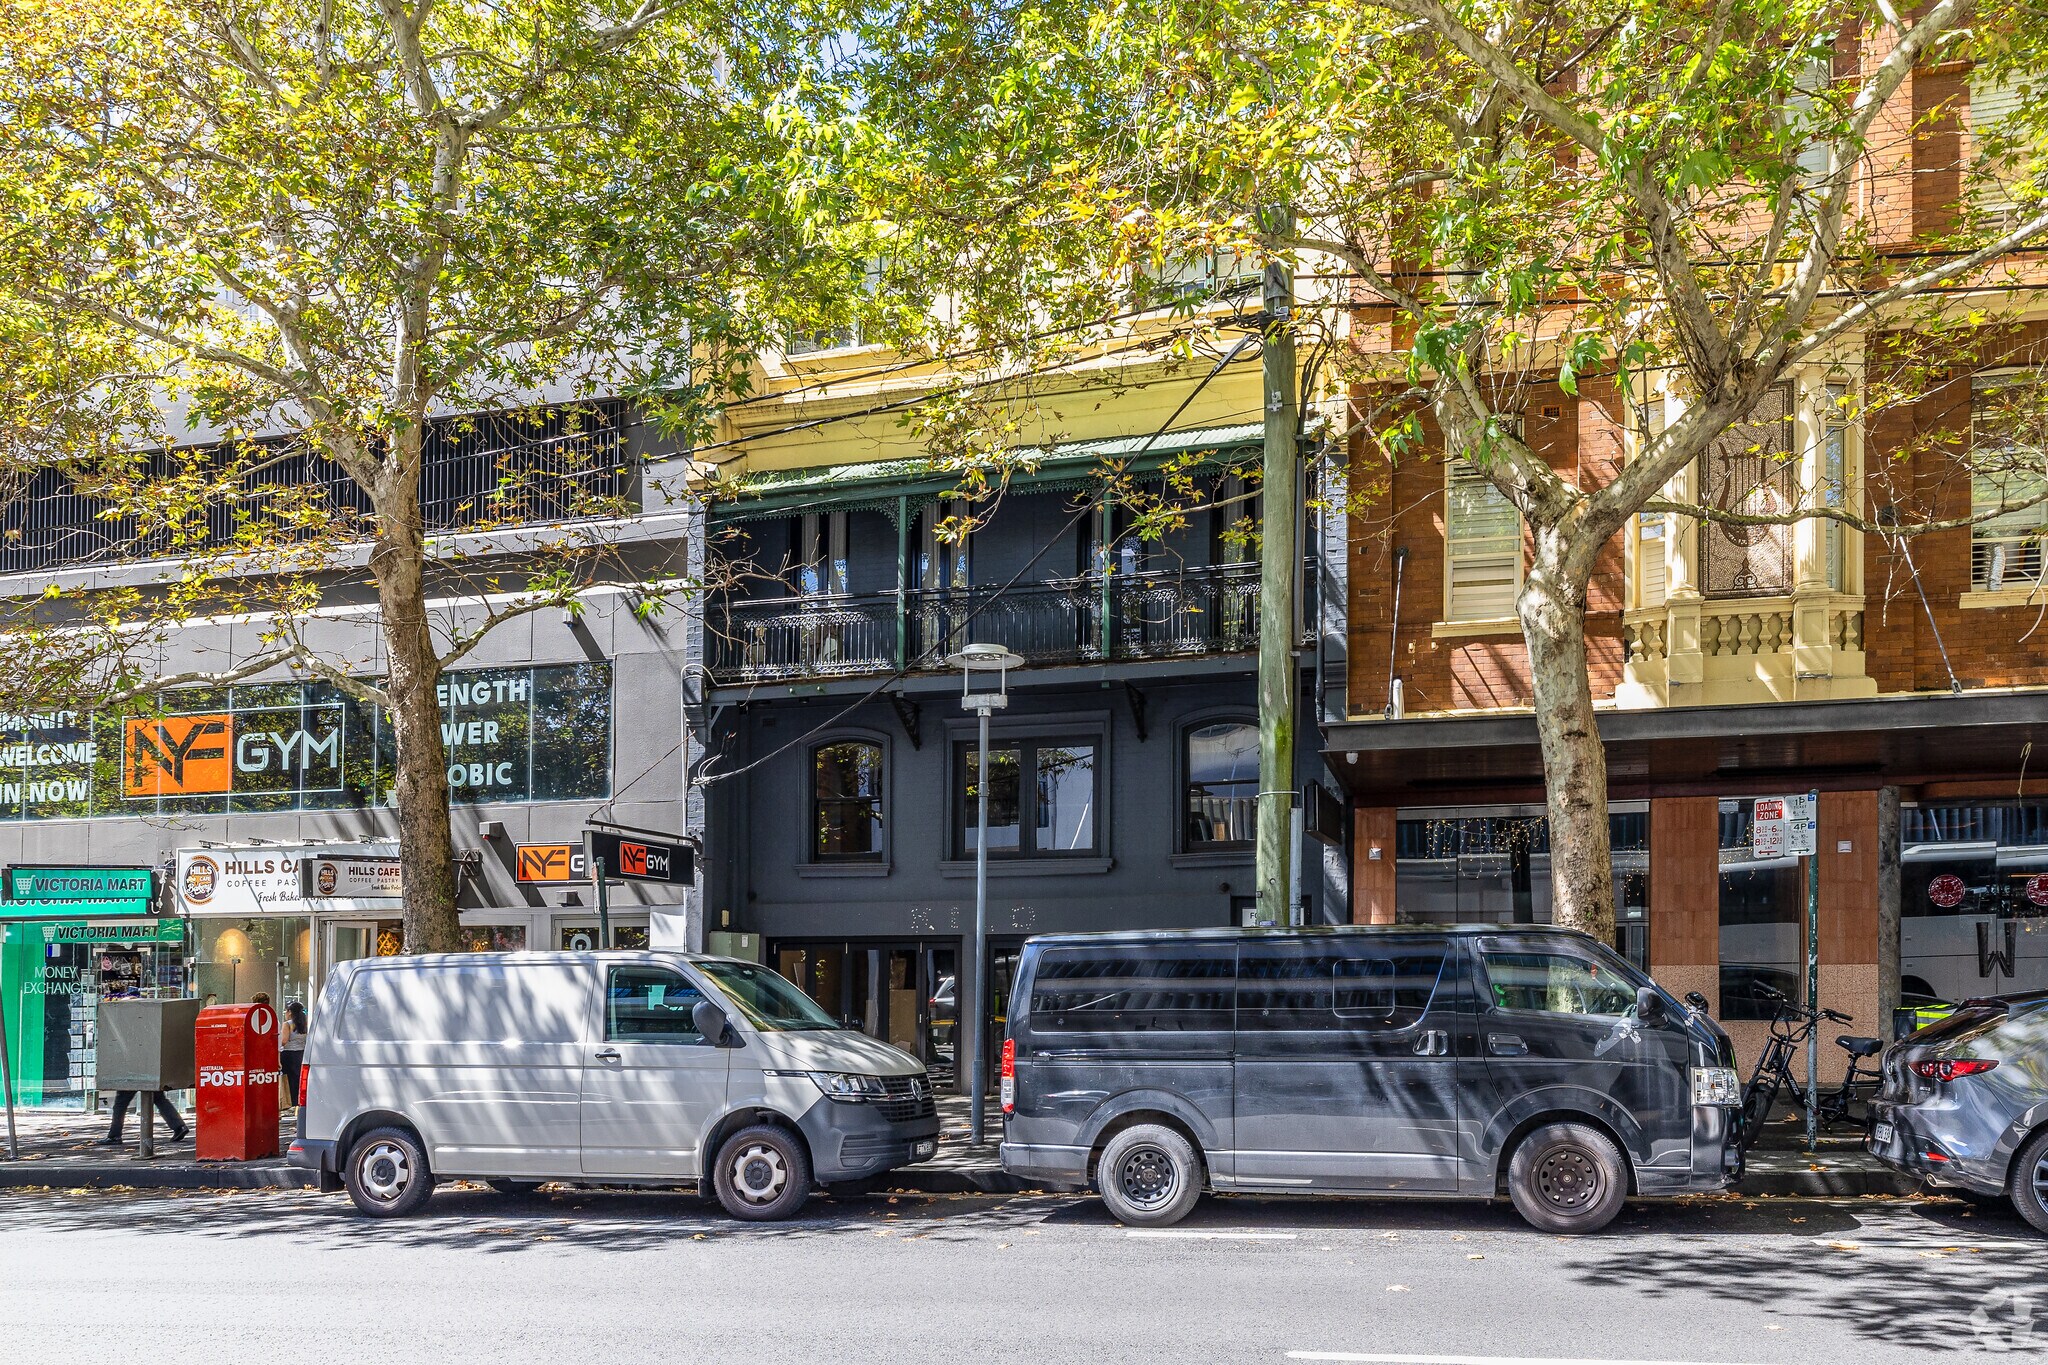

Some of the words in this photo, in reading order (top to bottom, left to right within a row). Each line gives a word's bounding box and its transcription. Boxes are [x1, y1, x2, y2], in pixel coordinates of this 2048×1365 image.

[437, 679, 526, 707] ENGTH
[441, 721, 499, 746] WER
[0, 743, 97, 767] WELCOME
[237, 728, 338, 772] GYM
[447, 762, 513, 787] OBIC
[30, 780, 88, 803] NOW
[1757, 801, 1782, 811] LOADING
[1760, 811, 1779, 820] ZONE
[225, 860, 275, 875] HILLS
[522, 849, 566, 878] NYF
[646, 854, 669, 872] GYM
[349, 867, 375, 876] HILLS
[377, 867, 400, 877] CAFE
[35, 878, 104, 892] VICTORIA
[107, 878, 147, 892] MART
[258, 891, 277, 902] Fresh
[58, 926, 118, 939] VICTORIA
[121, 926, 158, 938] MART
[34, 966, 78, 978] MONEY
[24, 982, 88, 994] EXCHANGE
[200, 1071, 245, 1087] POST
[248, 1071, 279, 1085] POST
